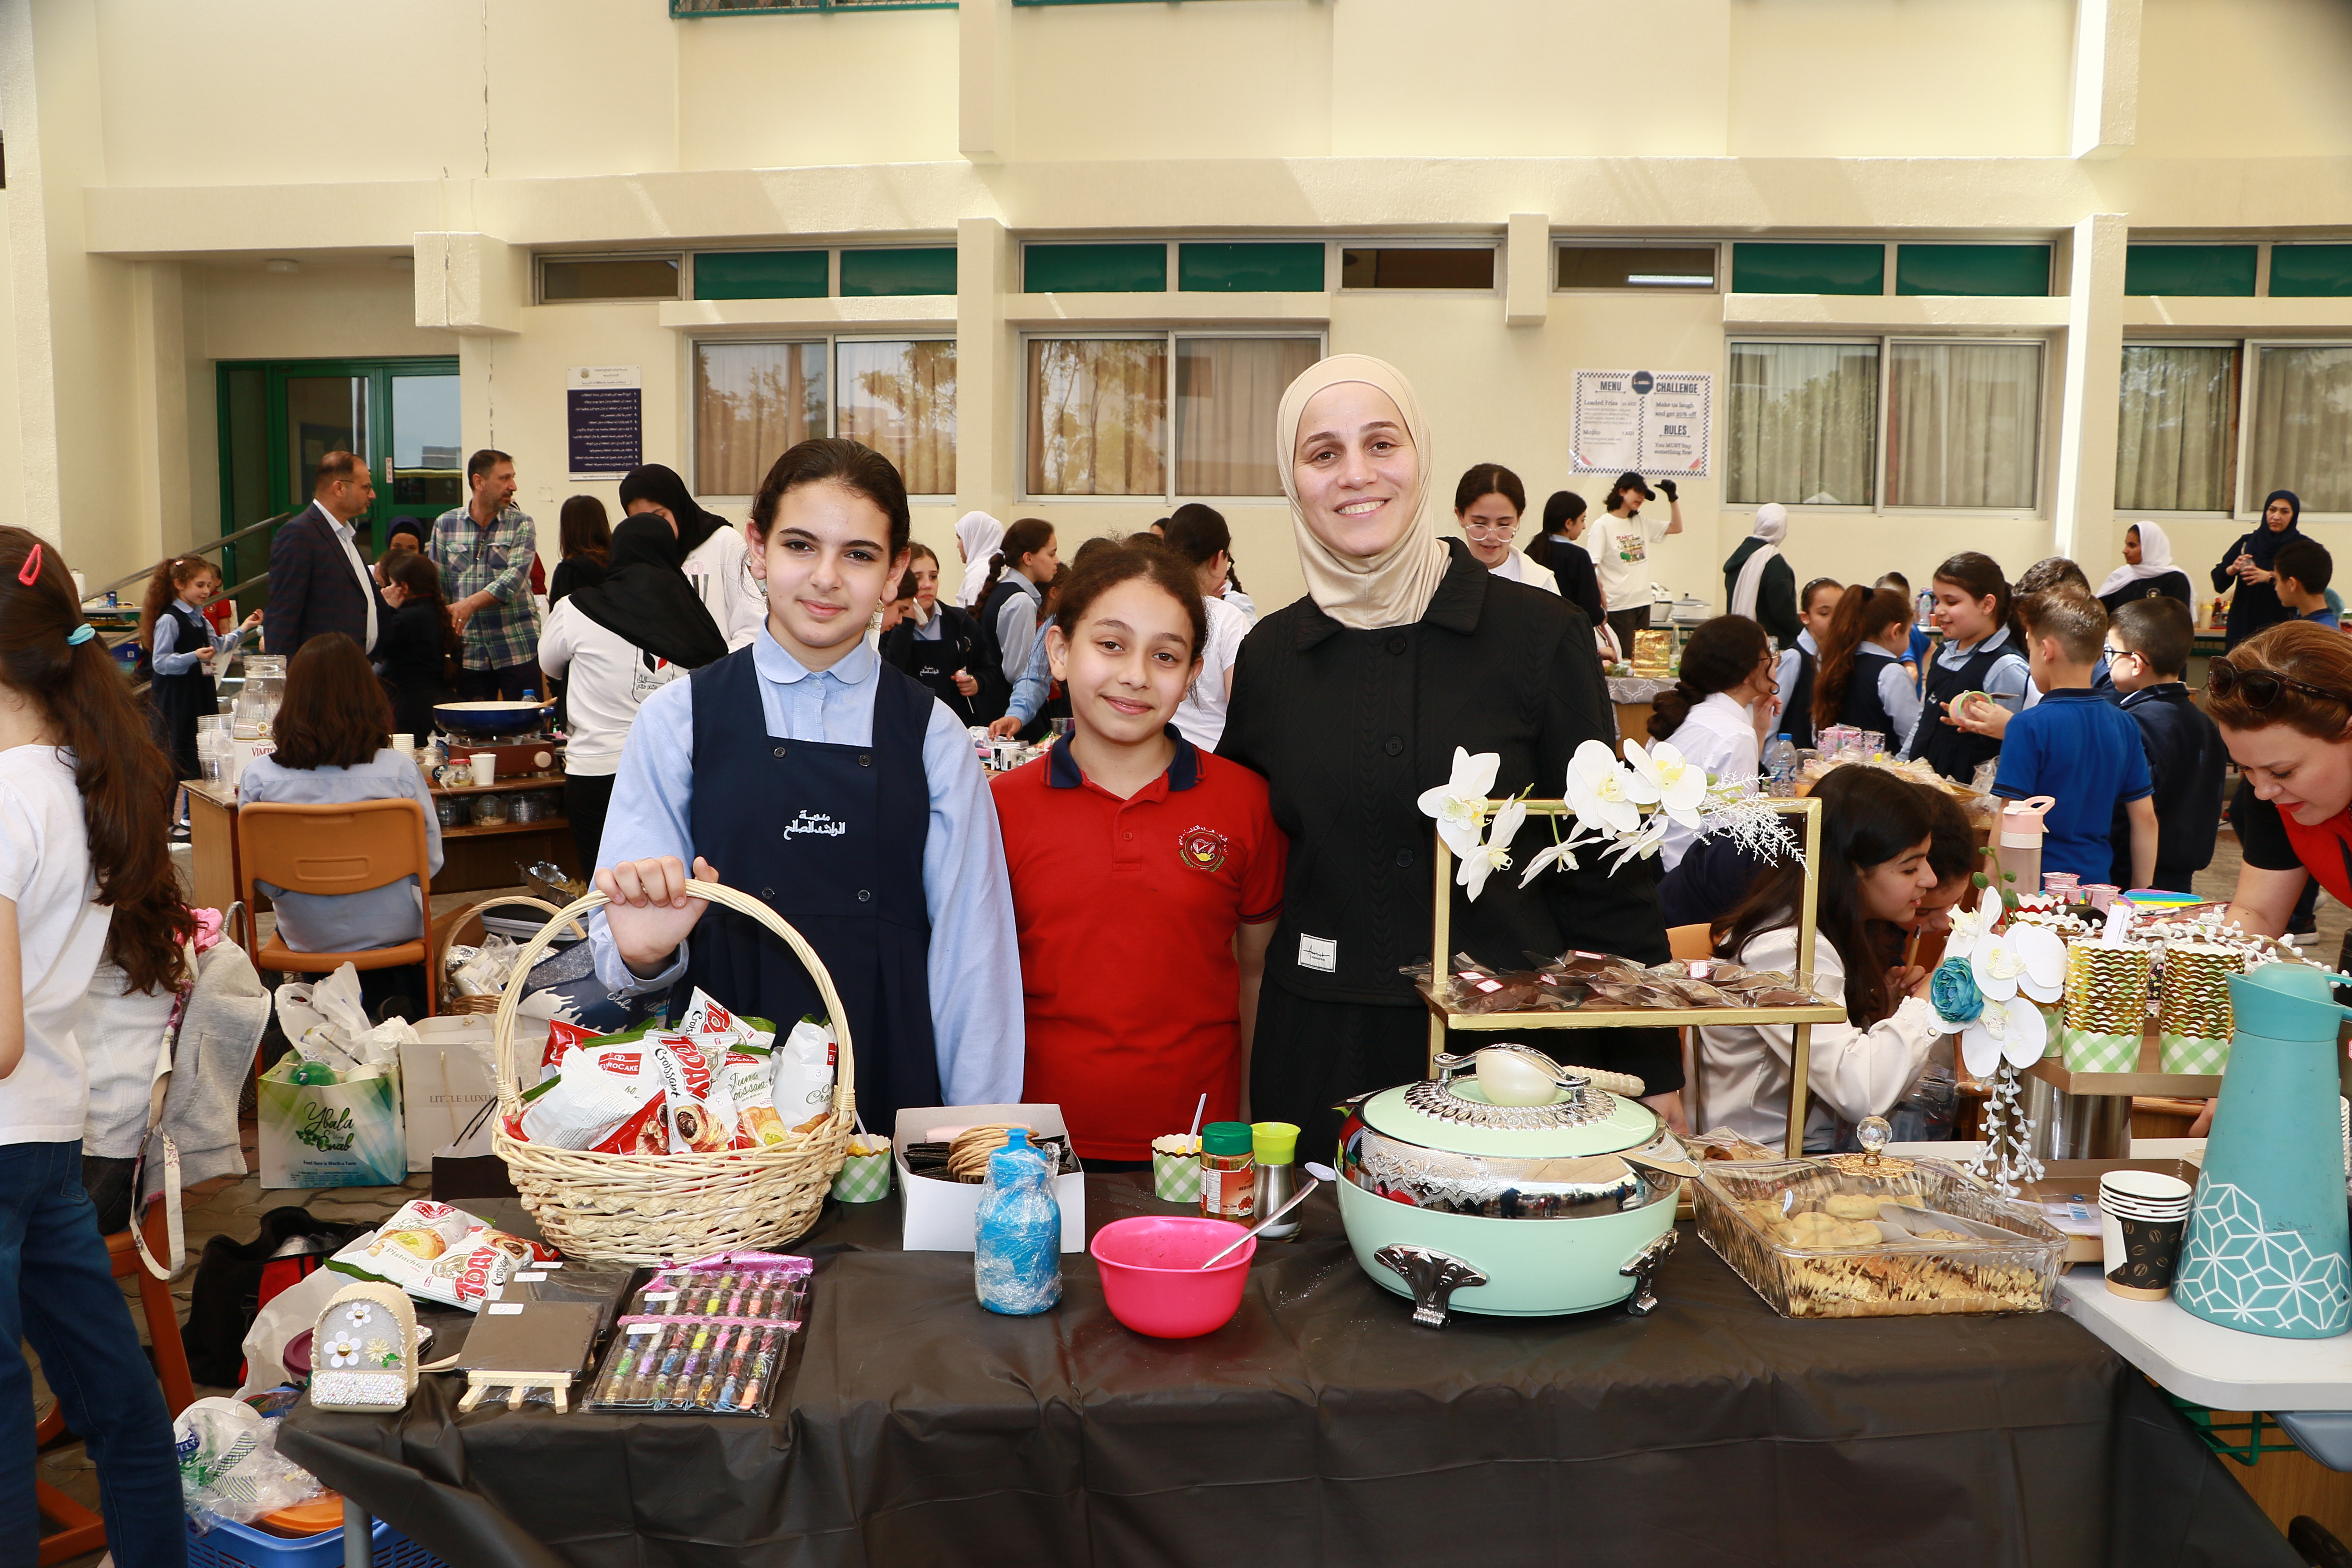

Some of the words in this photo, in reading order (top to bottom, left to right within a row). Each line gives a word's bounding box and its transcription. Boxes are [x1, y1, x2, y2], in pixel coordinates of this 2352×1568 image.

[1600, 381, 1621, 391] MENU
[1656, 382, 1698, 393] CHALLENGE
[1664, 424, 1687, 435] RULES
[606, 992, 632, 1011] Globa
[685, 1011, 703, 1035] Crois
[599, 1062, 639, 1072] EUROCAKE
[655, 1048, 681, 1098] Croissant
[661, 1036, 711, 1100] TODAY
[815, 1069, 822, 1077] 3
[733, 1081, 769, 1101] oissant
[386, 1247, 424, 1269] Pistachio
[455, 1247, 497, 1301] TODAY
[491, 1255, 512, 1286] Croissan
[499, 1305, 508, 1313] 5
